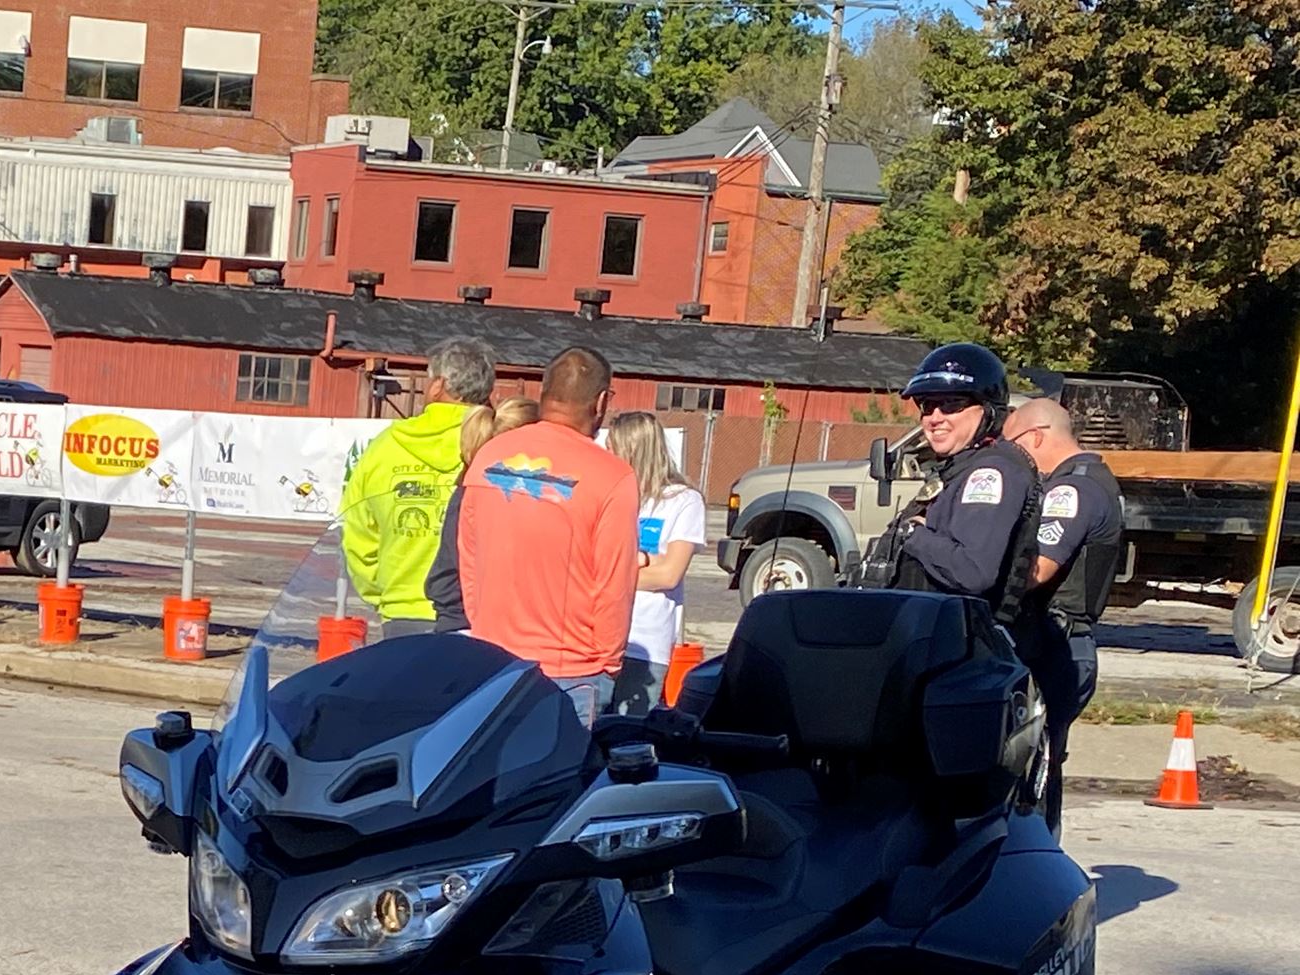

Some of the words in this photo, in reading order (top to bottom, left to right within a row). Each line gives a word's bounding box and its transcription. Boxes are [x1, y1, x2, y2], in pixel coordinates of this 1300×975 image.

[64, 432, 160, 460] INFOCUS
[216, 442, 235, 464] M
[95, 457, 146, 469] MARKETING
